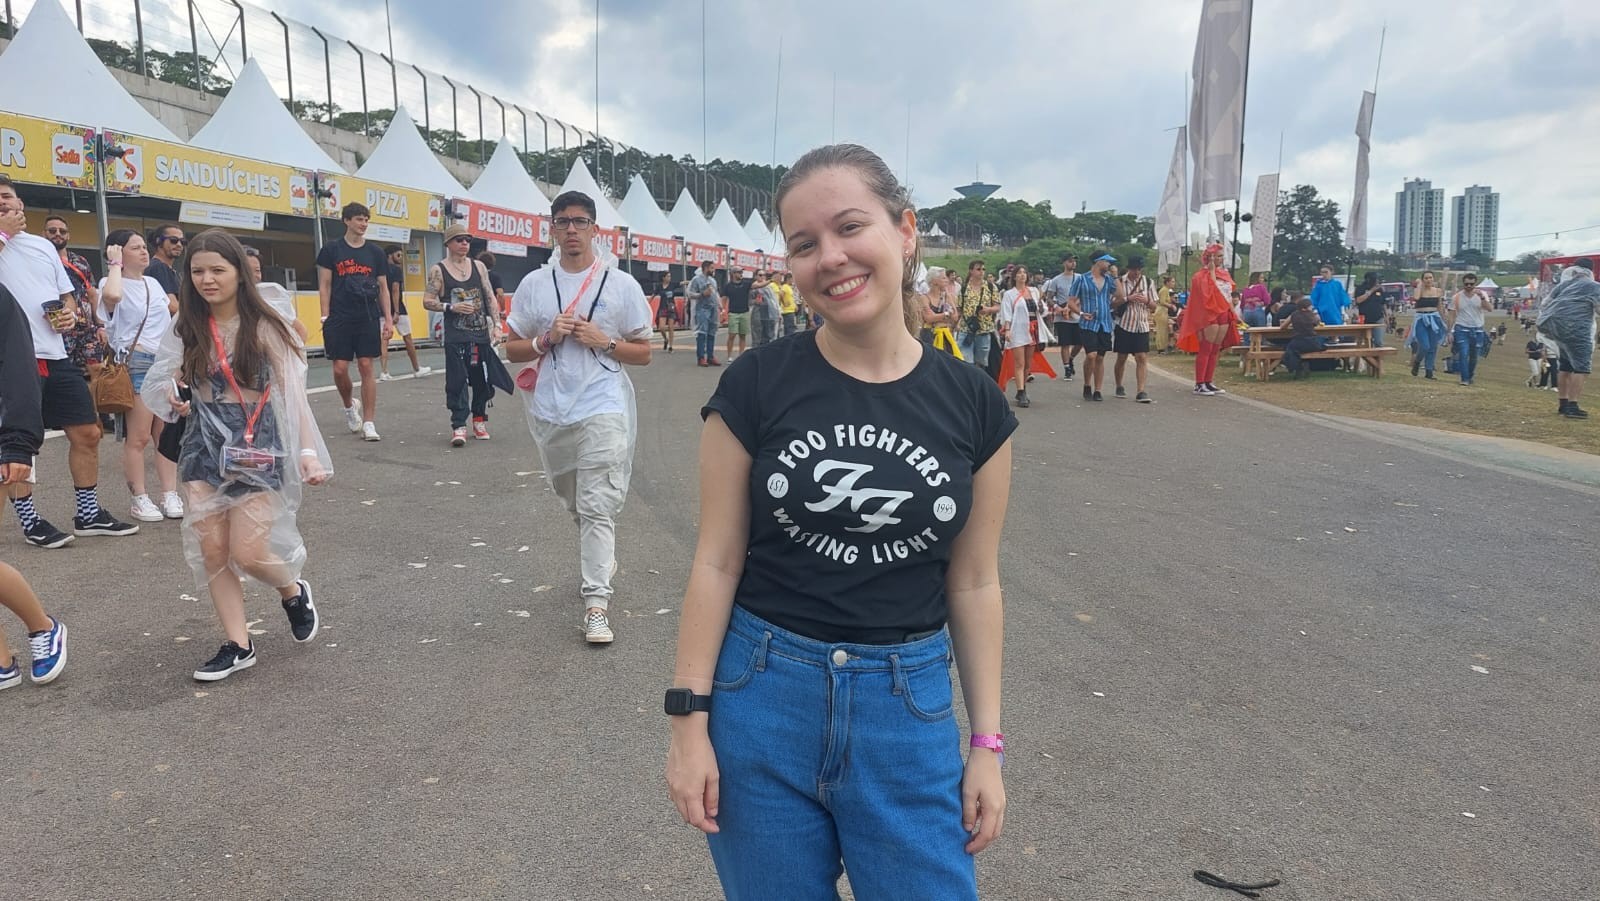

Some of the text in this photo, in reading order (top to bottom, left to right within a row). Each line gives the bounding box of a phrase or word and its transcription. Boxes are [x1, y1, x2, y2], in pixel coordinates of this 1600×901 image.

[155, 154, 281, 199] SANDUÍCHES
[365, 188, 409, 219] PIZZA
[478, 210, 533, 239] BEBIDAS
[642, 239, 673, 259] BEBIDAS
[695, 247, 719, 264] BEBIDAS
[777, 424, 951, 487] FOO FIGHTERS
[773, 507, 938, 564] WASTING LIGHT
